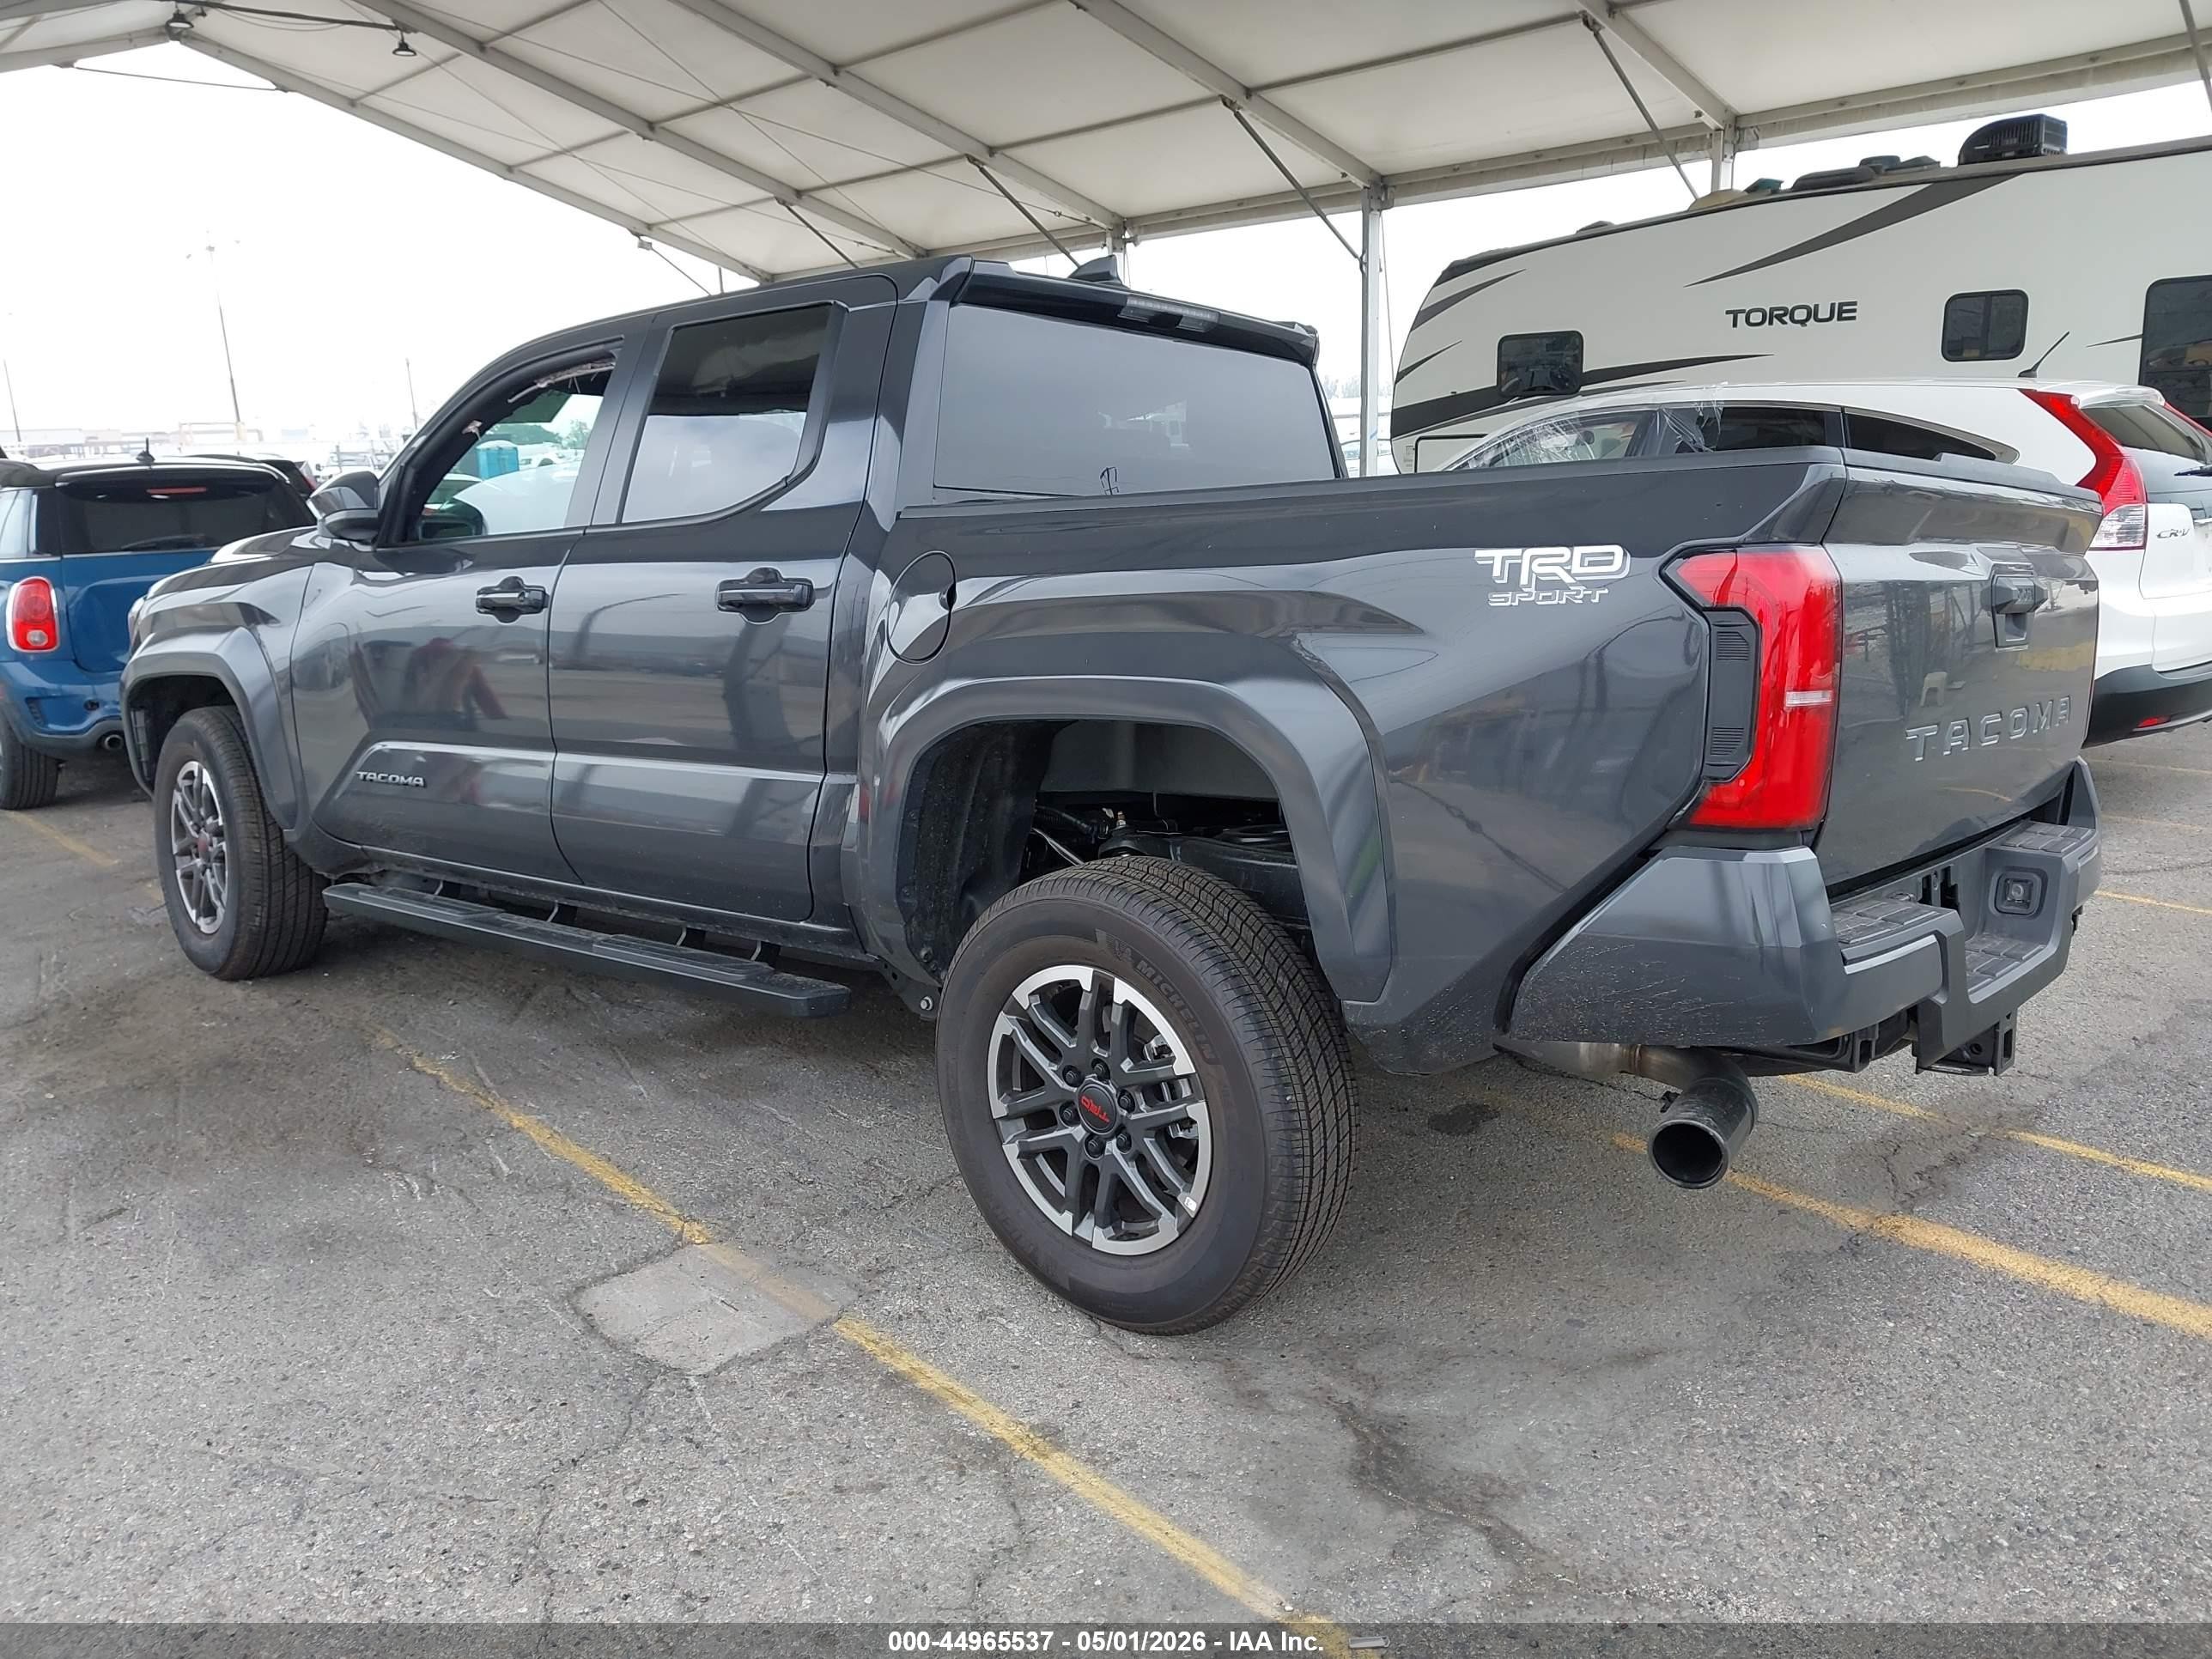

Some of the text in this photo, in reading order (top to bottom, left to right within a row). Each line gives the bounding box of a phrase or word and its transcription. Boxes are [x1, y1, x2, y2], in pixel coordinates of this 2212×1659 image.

[1724, 301, 1858, 329] TORQUE
[1474, 544, 1632, 592] TRD
[1487, 587, 1609, 607] SPORT
[1905, 695, 2071, 763] TACOMA
[356, 770, 427, 788] TACOMA
[1136, 959, 1216, 1060] MICHELIN
